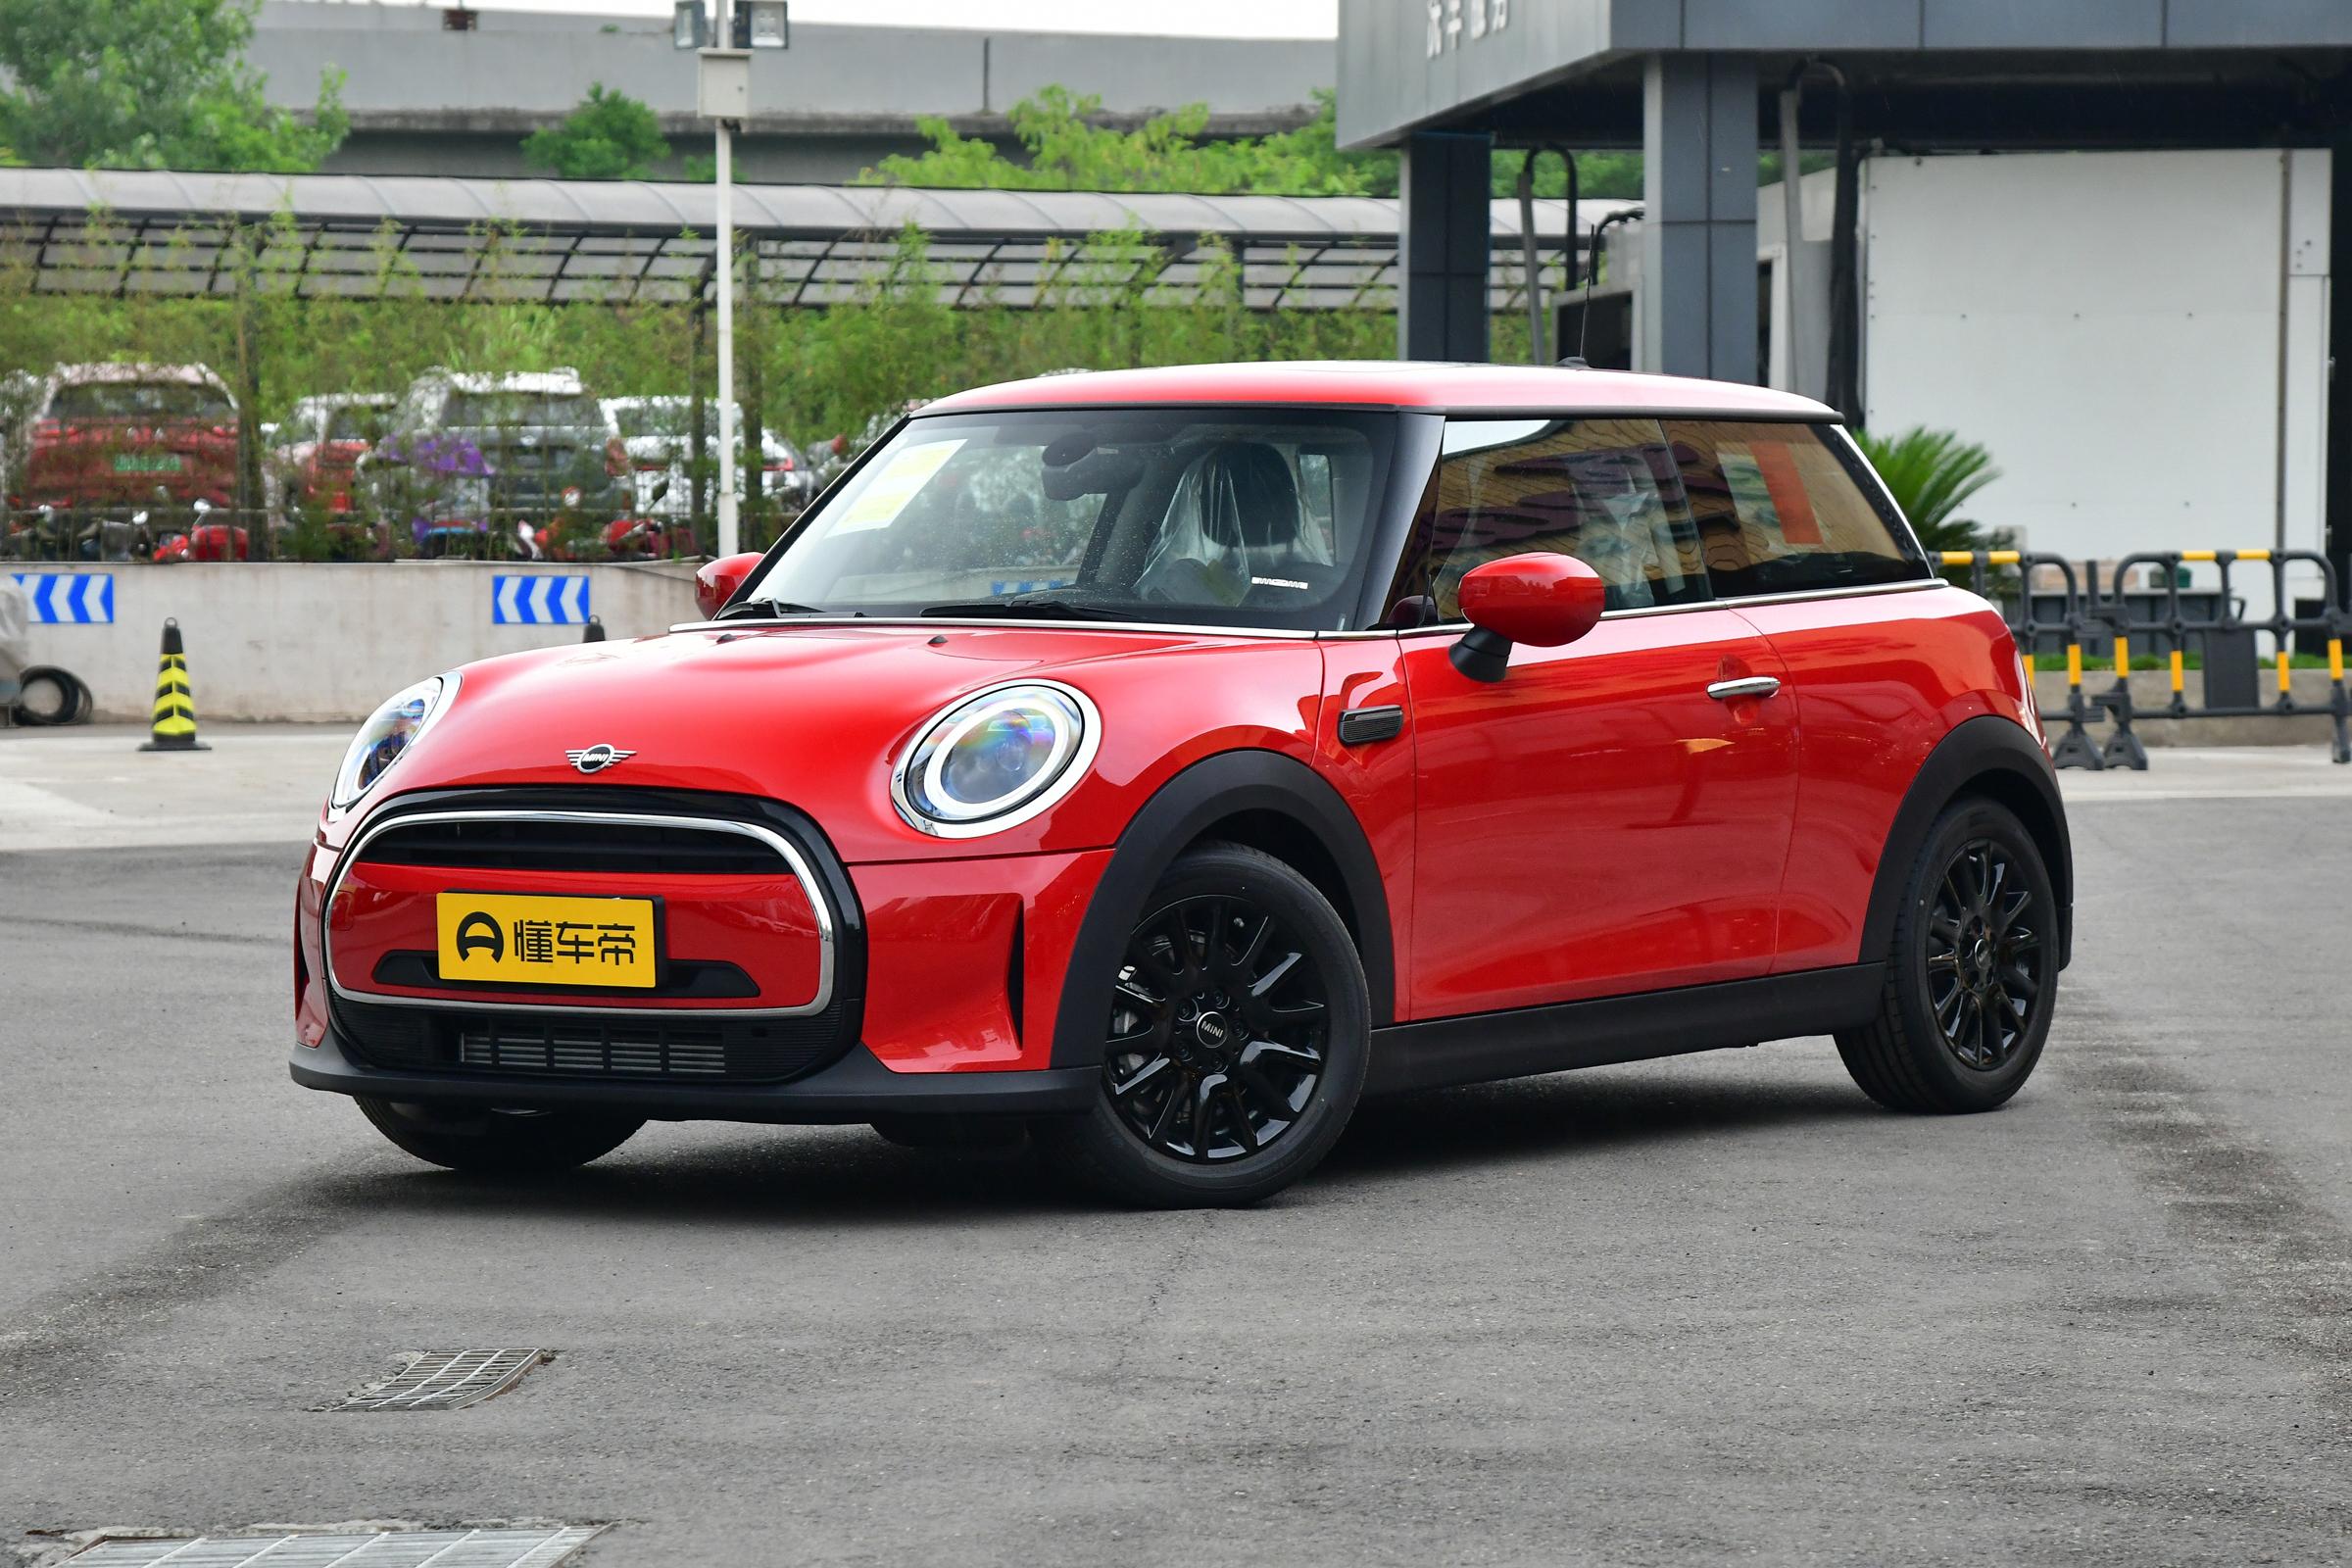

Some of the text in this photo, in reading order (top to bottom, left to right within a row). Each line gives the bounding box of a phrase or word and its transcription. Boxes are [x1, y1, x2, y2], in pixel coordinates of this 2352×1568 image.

[514, 919, 636, 965] 懂车帝
[1200, 1020, 1224, 1038] MINI
